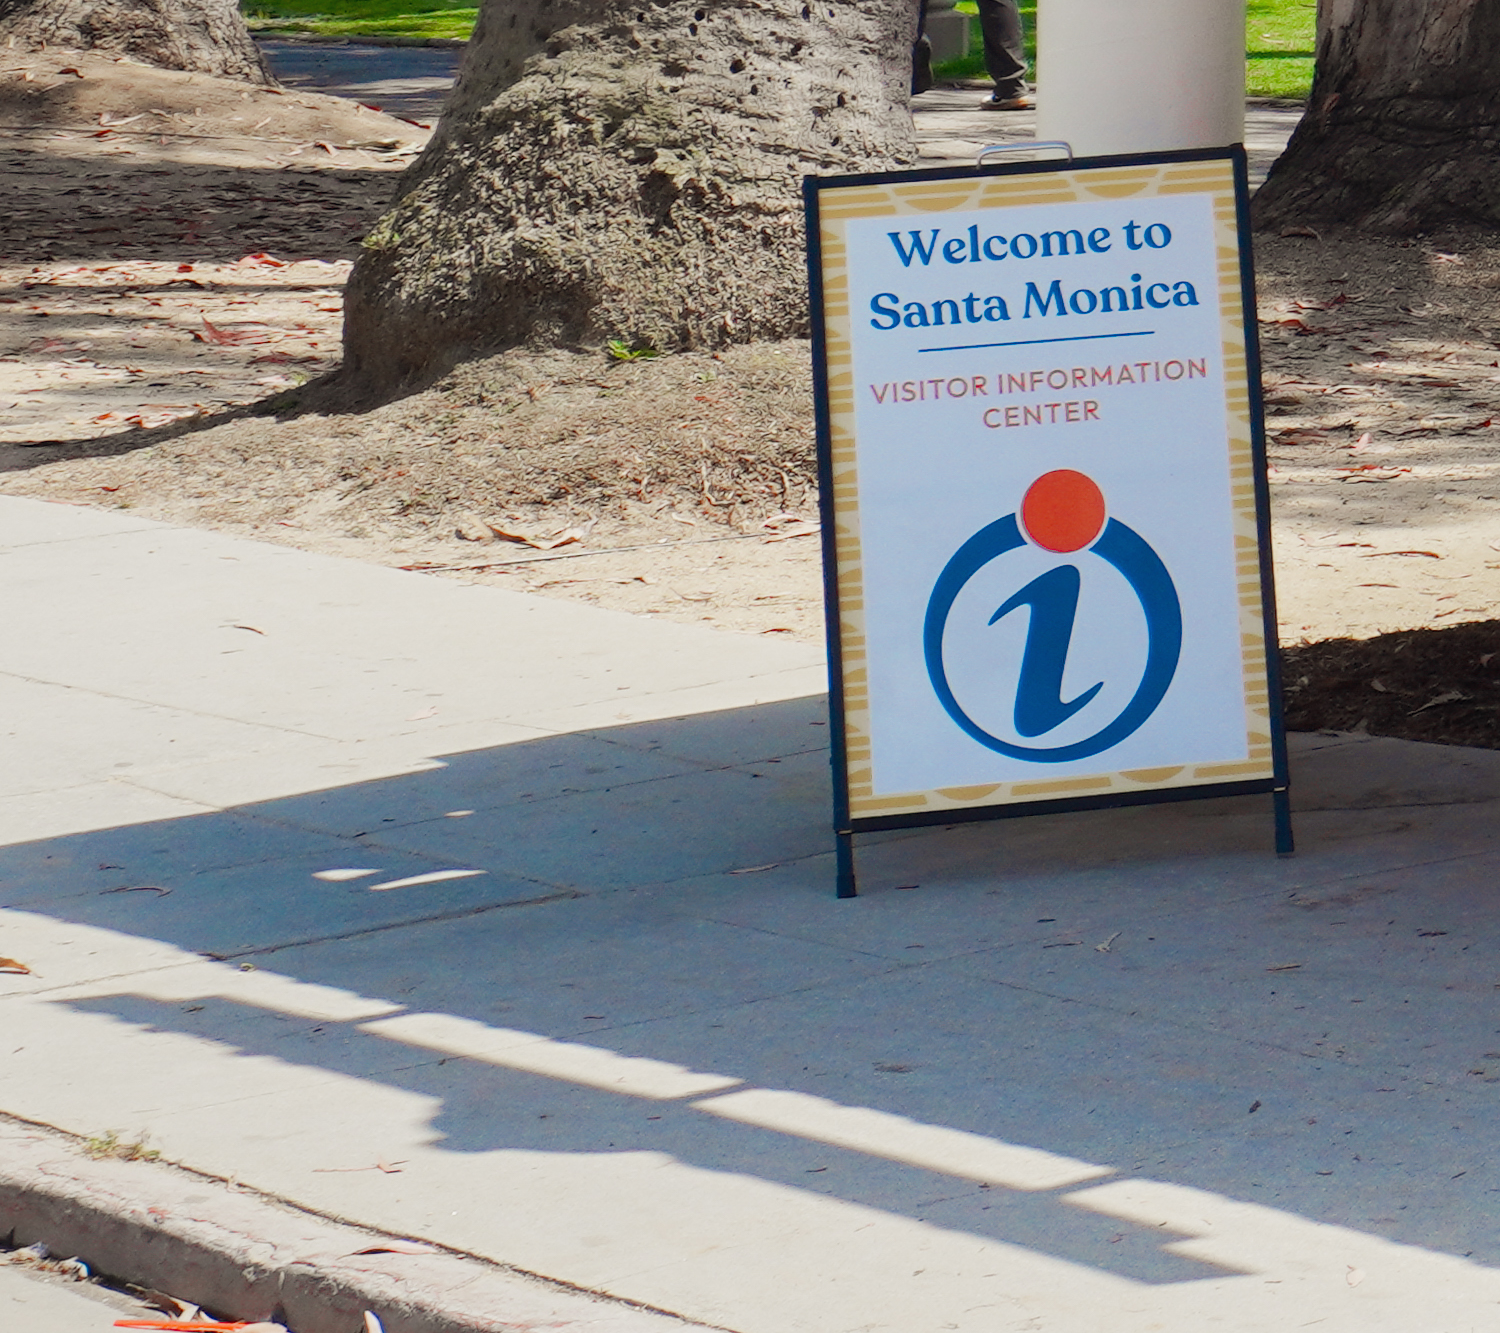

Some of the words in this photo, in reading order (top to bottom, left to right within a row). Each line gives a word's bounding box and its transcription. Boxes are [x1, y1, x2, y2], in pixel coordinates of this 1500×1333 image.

[888, 218, 1113, 269] Welcome
[1123, 219, 1172, 251] to
[869, 289, 1011, 331] Santa
[1022, 271, 1200, 321] Monica
[870, 374, 989, 405] VISITOR
[997, 357, 1208, 395] INFORMATION
[982, 399, 1101, 431] CENTER
